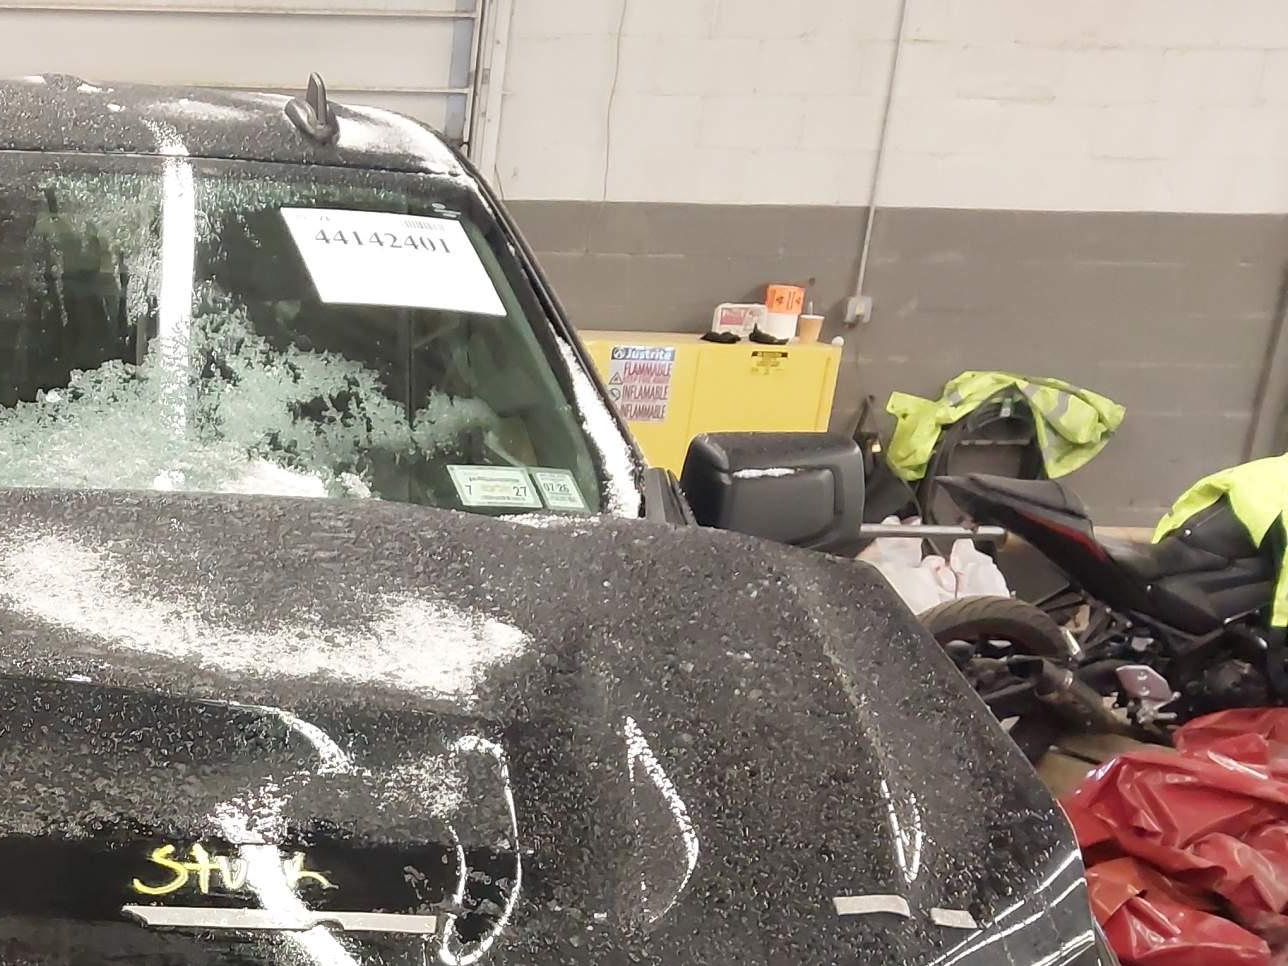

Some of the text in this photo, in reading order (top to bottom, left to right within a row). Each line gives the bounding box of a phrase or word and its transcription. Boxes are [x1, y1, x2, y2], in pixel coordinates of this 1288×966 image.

[315, 229, 452, 253] 44142401
[623, 361, 671, 377] FLAMMABLE
[513, 486, 527, 497] 27
